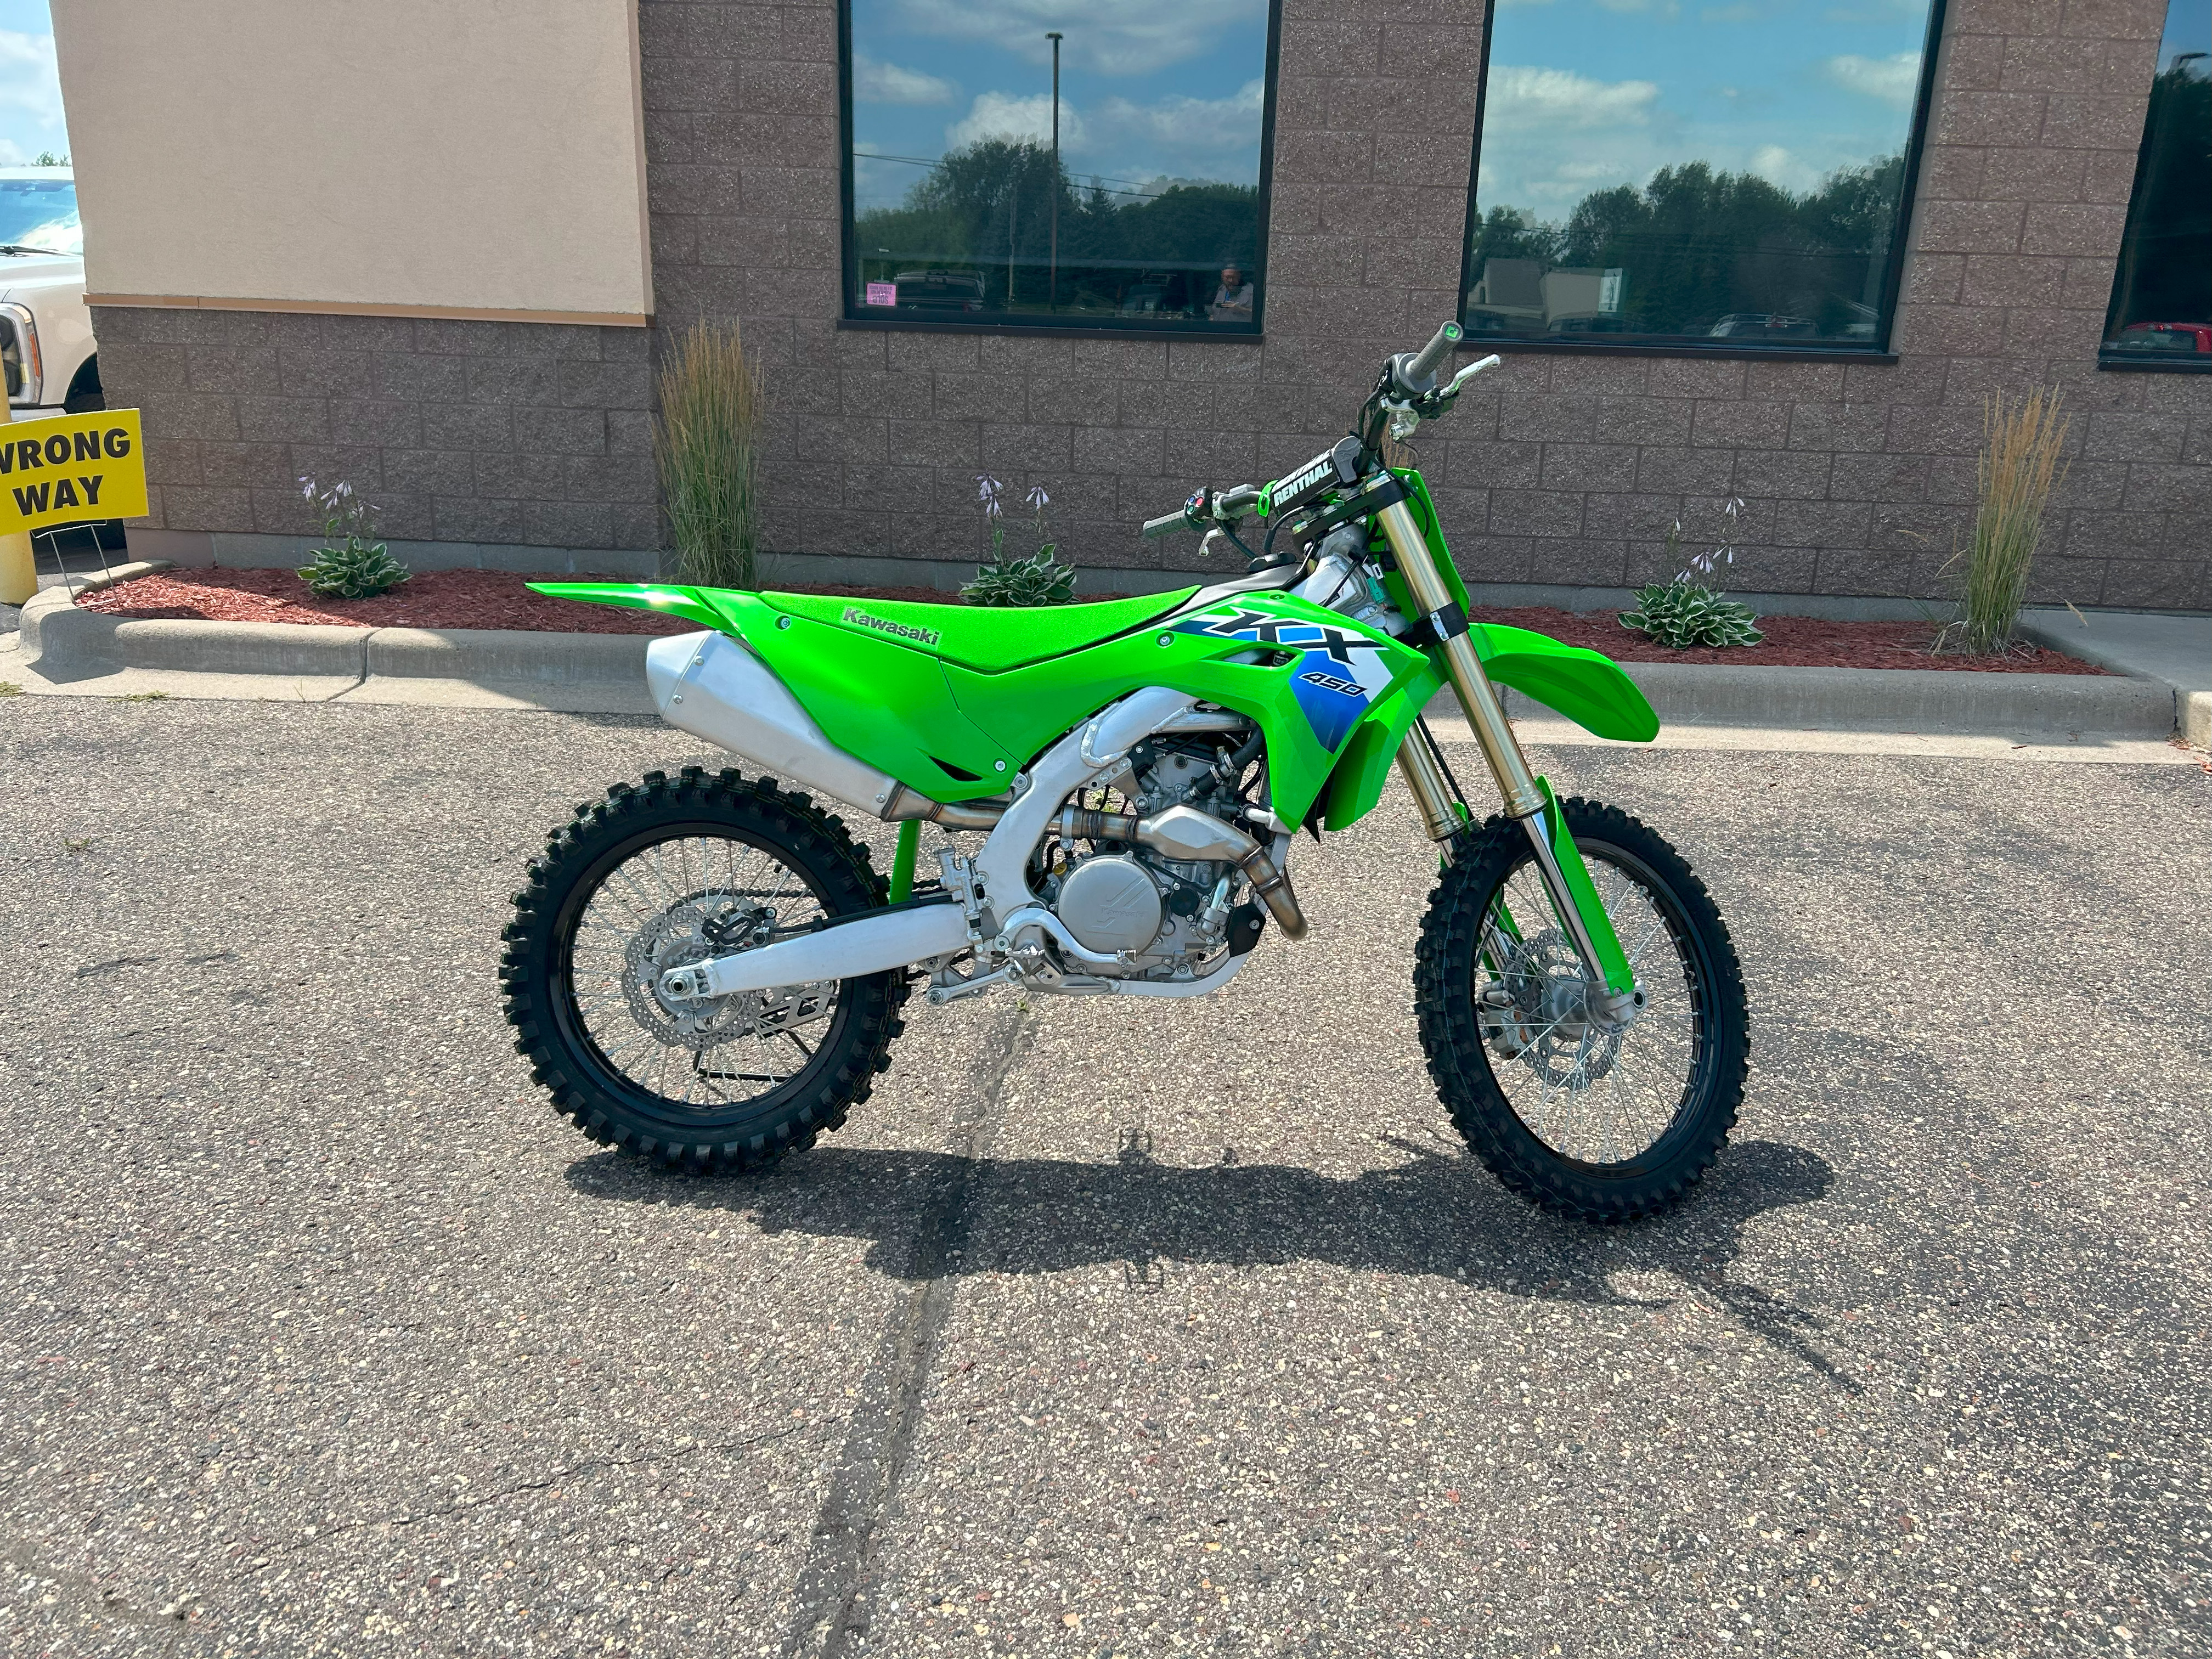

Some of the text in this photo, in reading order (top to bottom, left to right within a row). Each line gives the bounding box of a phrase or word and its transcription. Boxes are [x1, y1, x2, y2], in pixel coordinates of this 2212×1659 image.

[12, 475, 104, 516] WAY
[1273, 461, 1333, 507] RENTHAL
[843, 607, 940, 646] Kawasaki
[1301, 672, 1368, 697] 450
